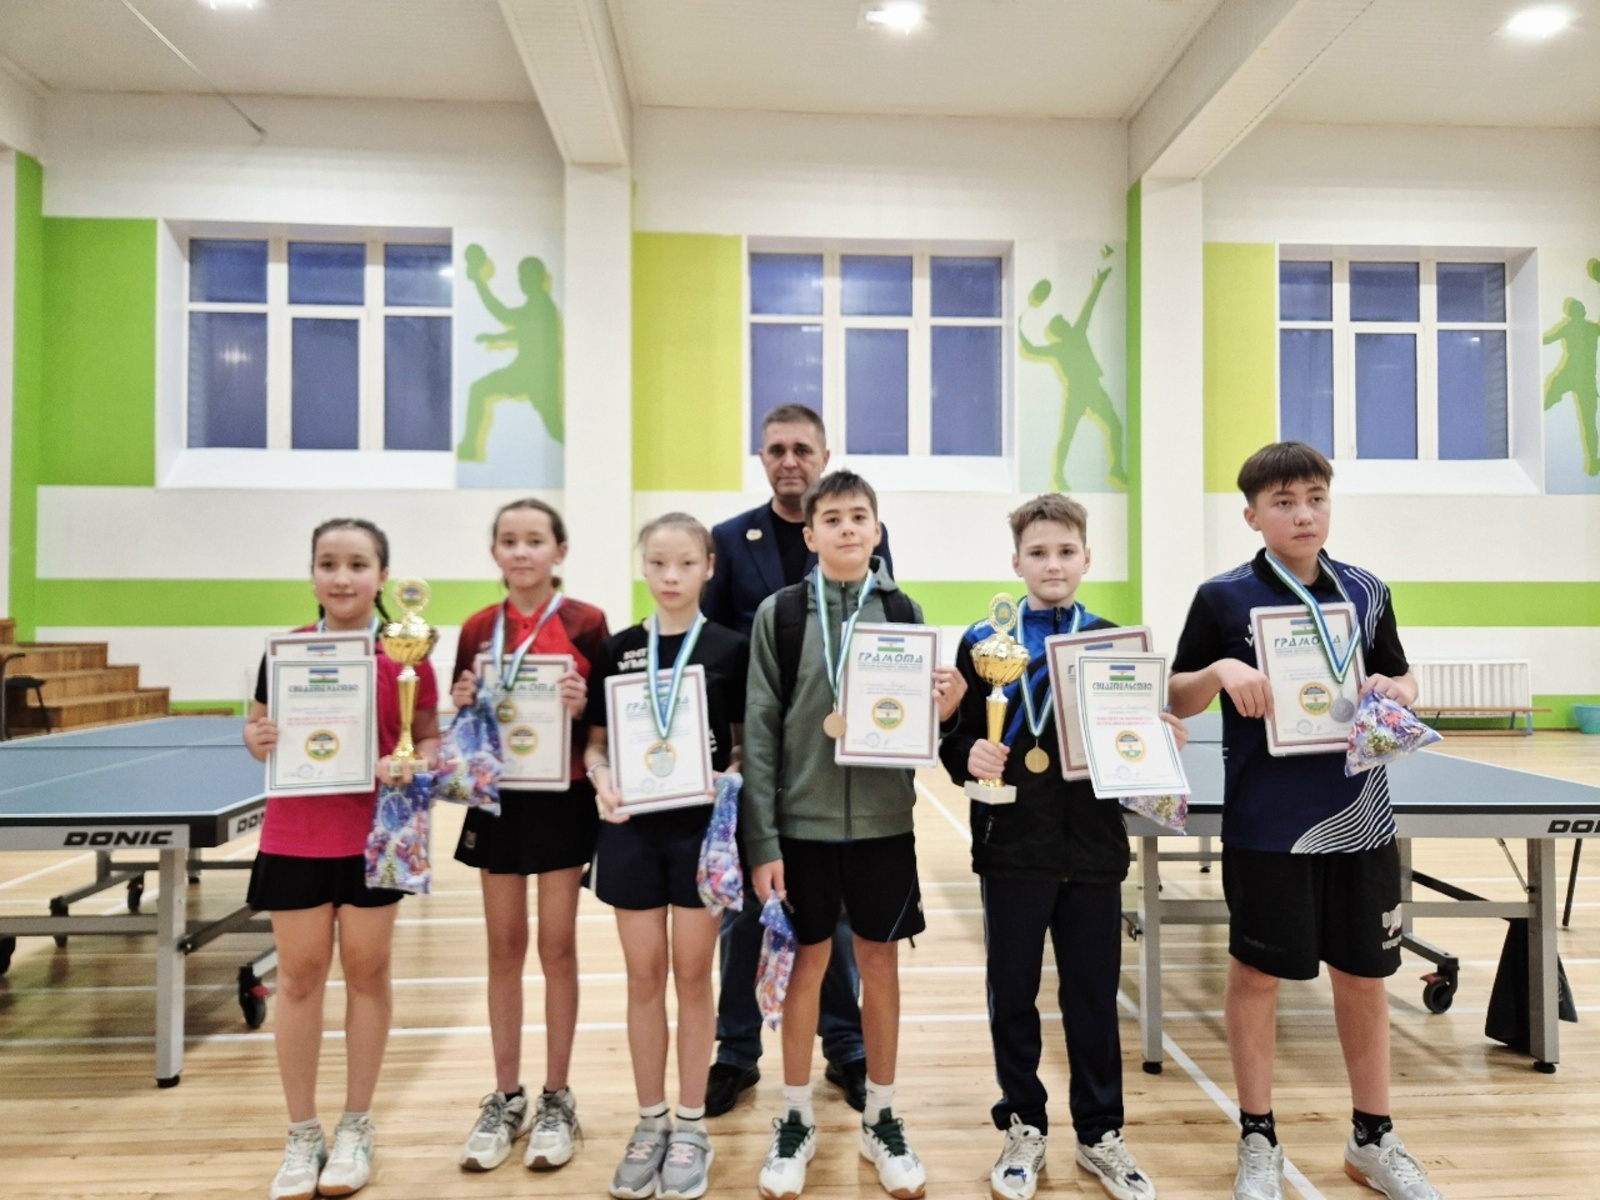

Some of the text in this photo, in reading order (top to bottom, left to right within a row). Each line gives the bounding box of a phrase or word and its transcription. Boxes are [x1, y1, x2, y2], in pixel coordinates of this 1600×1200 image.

[1274, 635, 1341, 648] ГРАМОА
[858, 652, 924, 663] ГРАМОТА
[63, 830, 173, 846] DONIC
